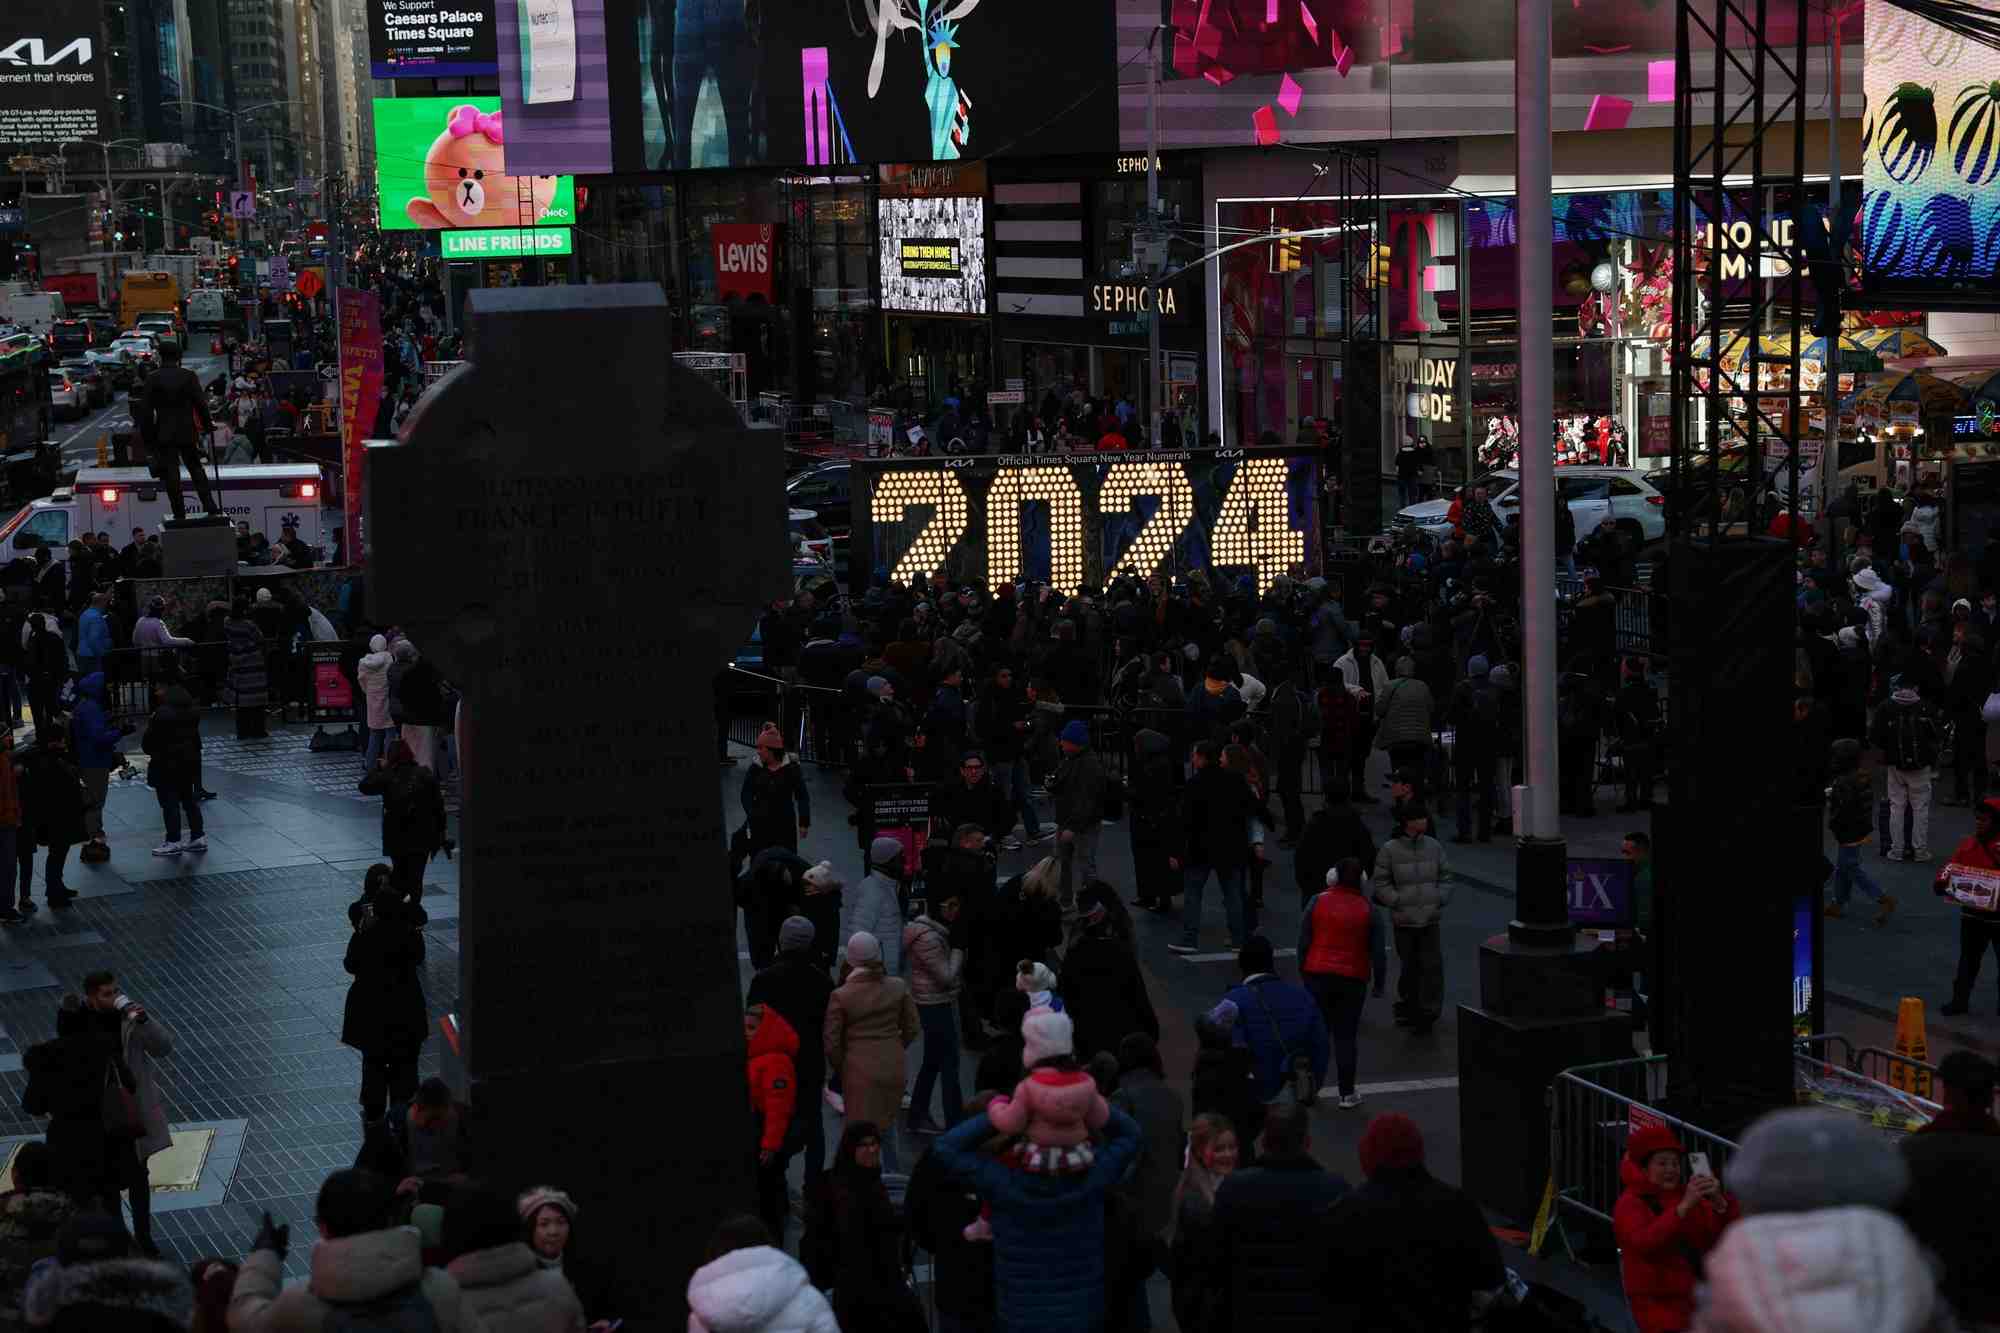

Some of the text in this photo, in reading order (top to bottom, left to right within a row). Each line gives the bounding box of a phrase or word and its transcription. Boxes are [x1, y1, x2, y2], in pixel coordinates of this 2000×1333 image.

[384, 0, 434, 11] We Support
[384, 10, 483, 25] Caesars Palace
[385, 26, 474, 41] Times Square
[34, 72, 54, 82] that
[56, 72, 94, 84] inspires
[1117, 157, 1162, 172] SEPHOA
[448, 234, 563, 252] LINE FRIENDS
[998, 451, 1191, 466] Official Times Square New Year Numerals
[871, 458, 1305, 598] 2024
